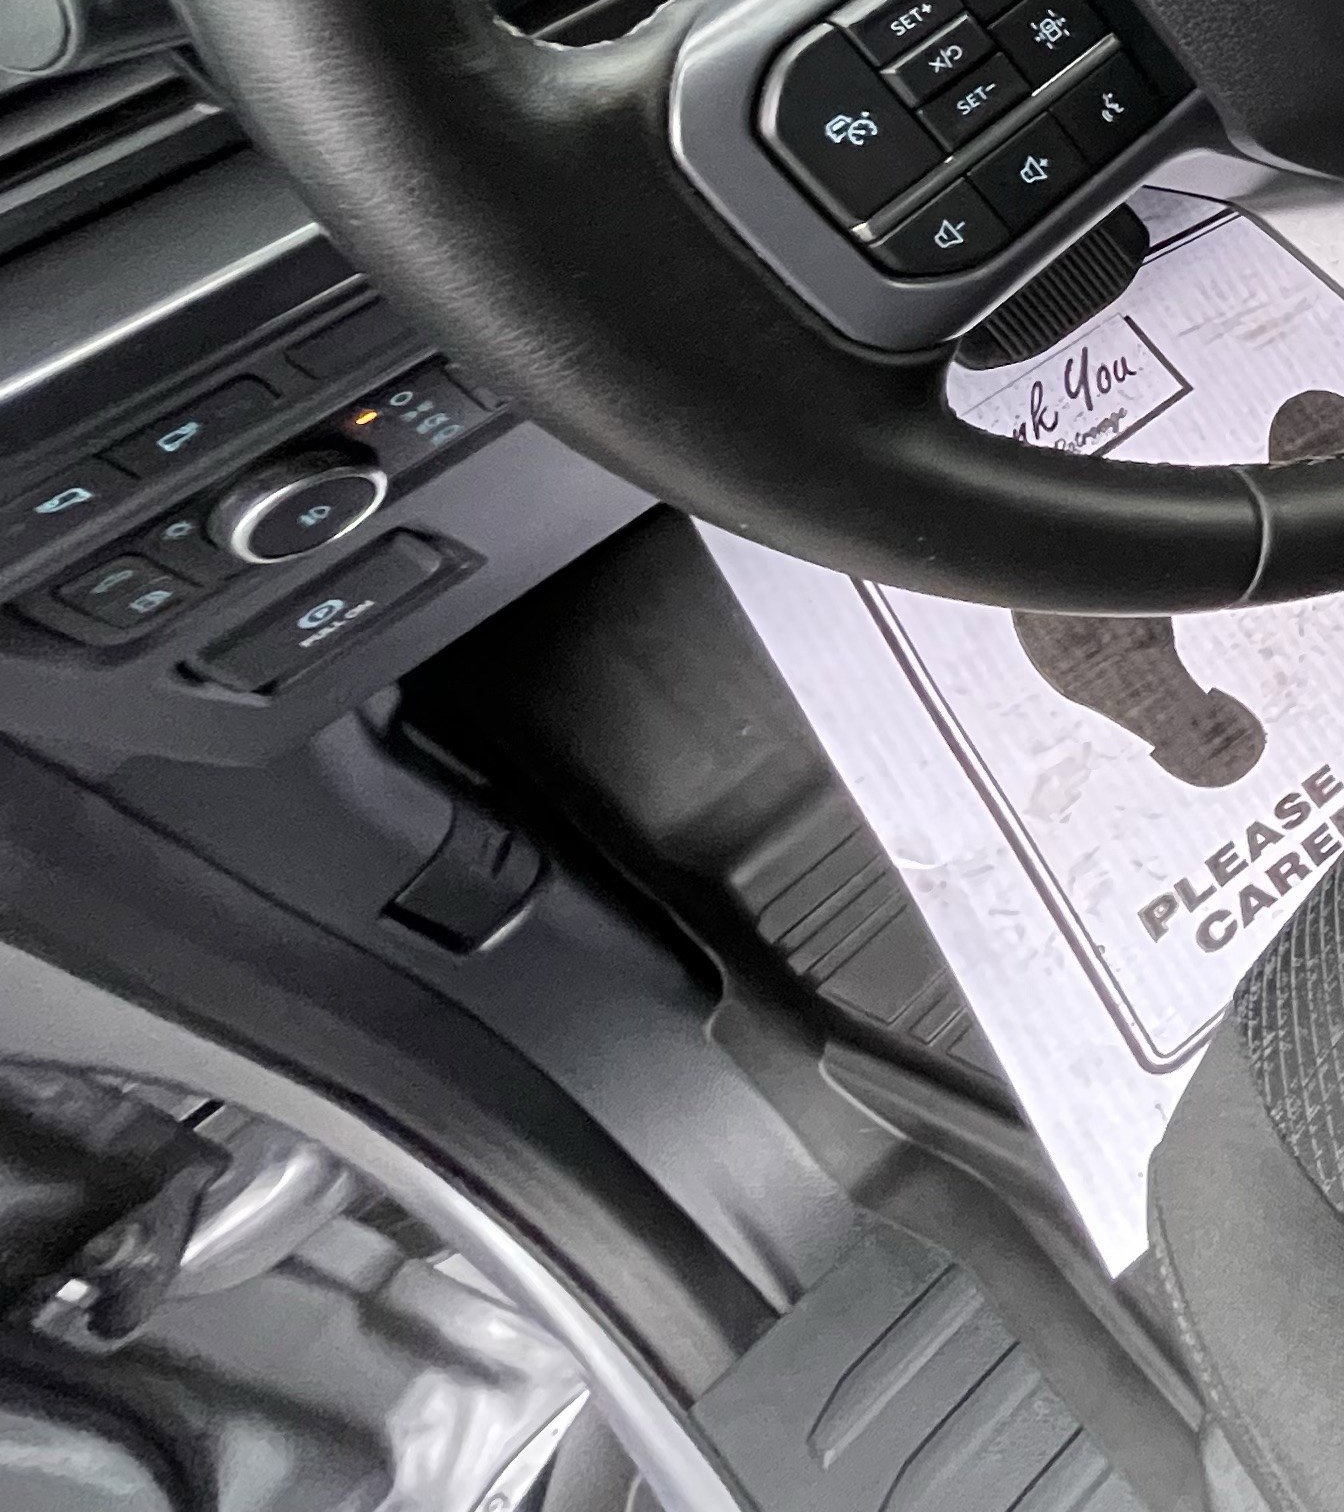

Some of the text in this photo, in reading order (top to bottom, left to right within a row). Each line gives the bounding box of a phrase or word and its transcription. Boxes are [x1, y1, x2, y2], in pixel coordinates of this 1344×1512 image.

[890, 2, 933, 37] SET+
[1064, 346, 1137, 411] You
[1137, 764, 1344, 943] PLEASE
